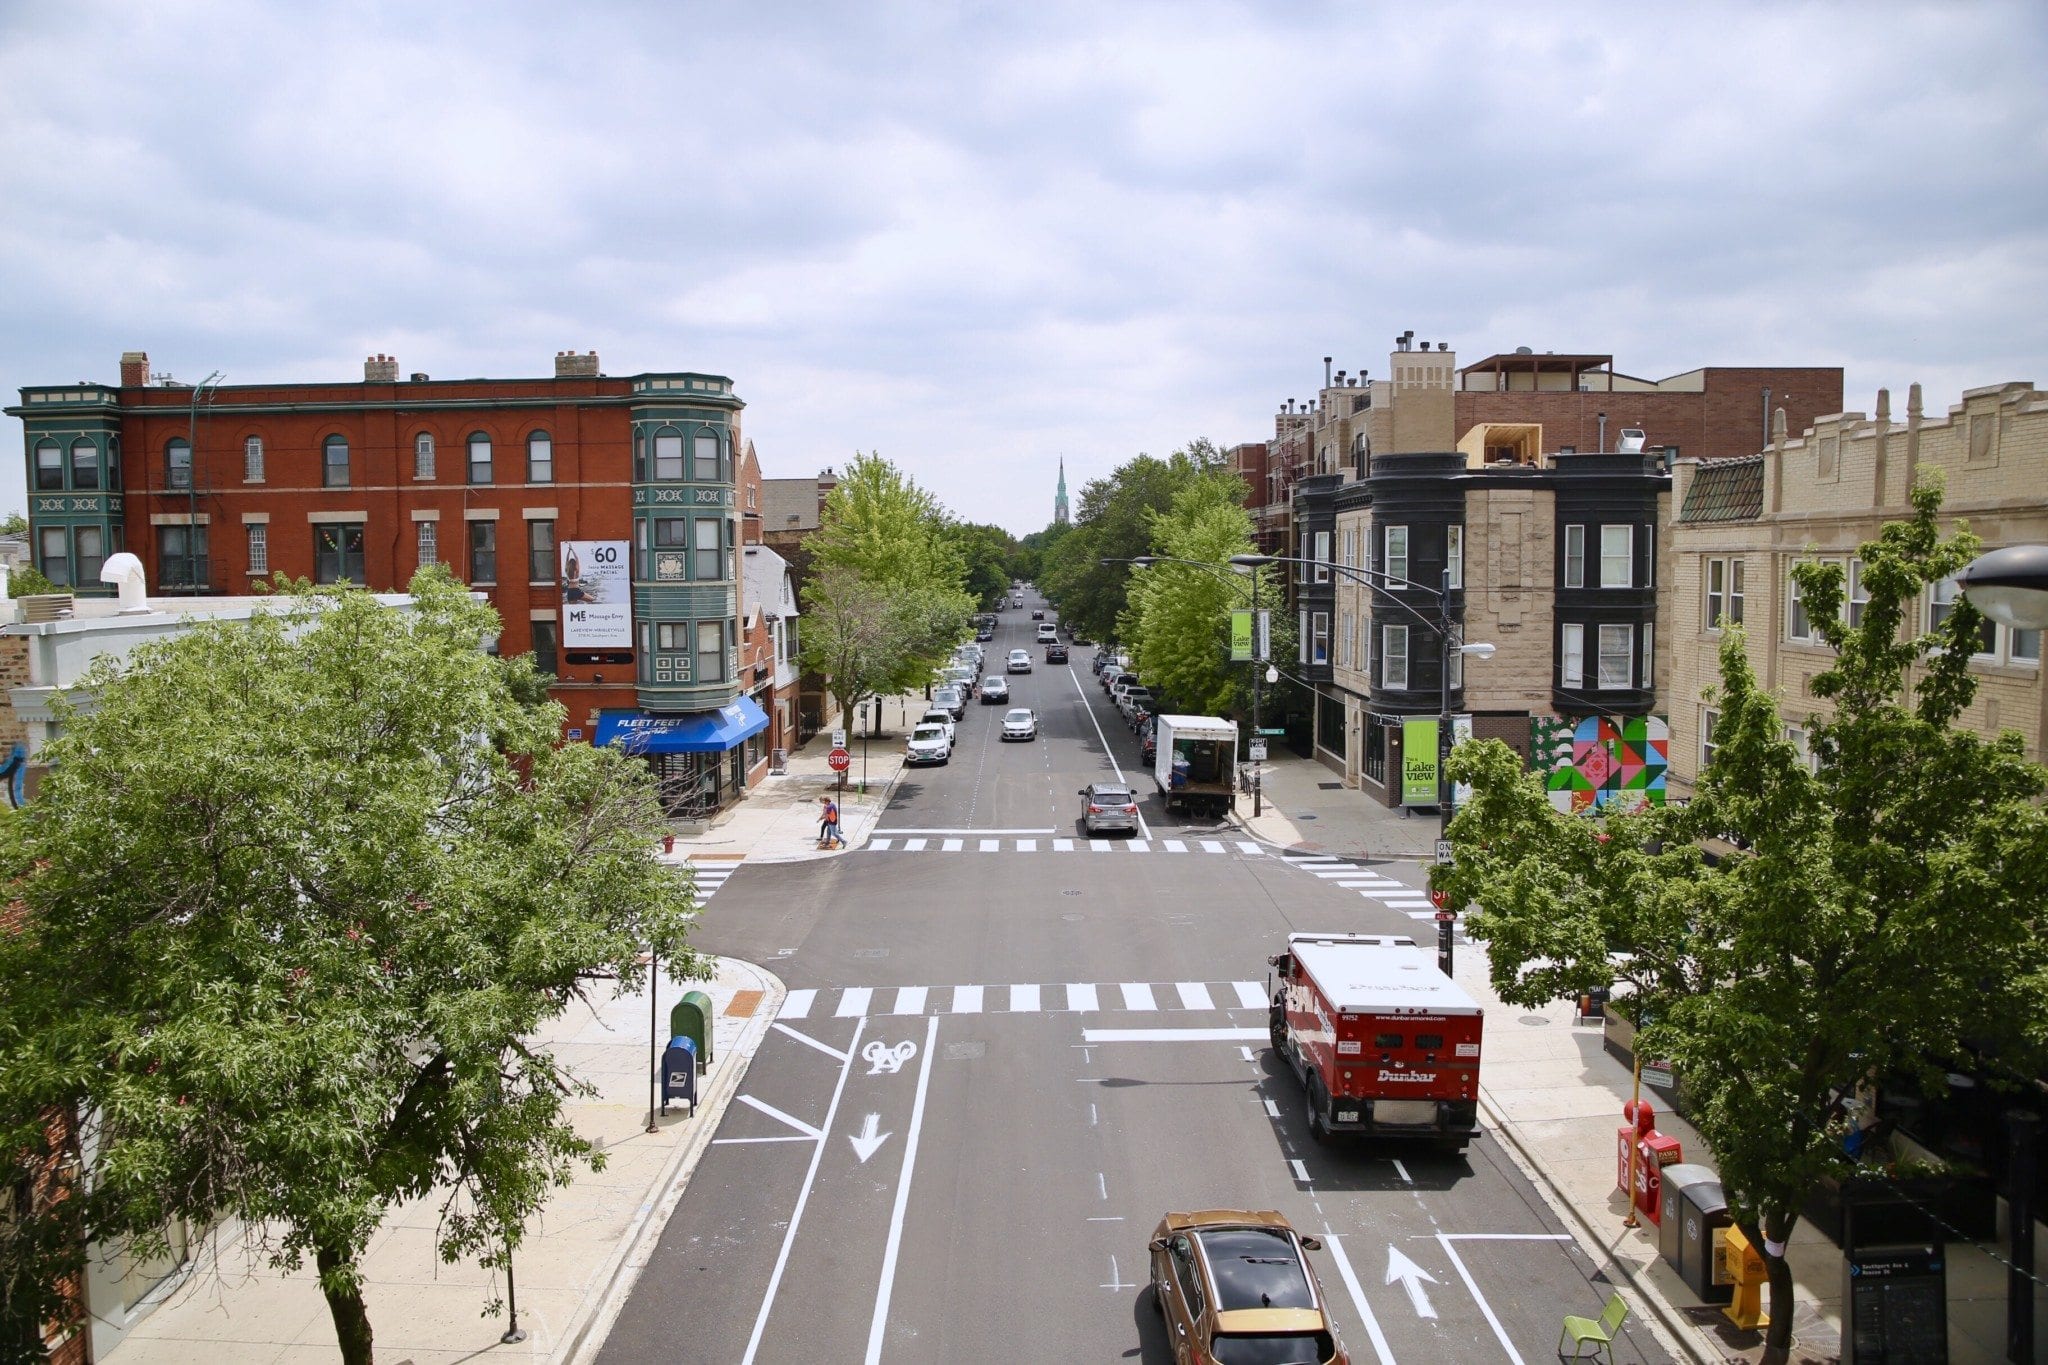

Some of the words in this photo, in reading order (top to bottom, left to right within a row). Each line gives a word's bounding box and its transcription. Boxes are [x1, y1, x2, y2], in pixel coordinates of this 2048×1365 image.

[570, 610, 587, 622] ME
[588, 612, 611, 621] Massage
[611, 612, 624, 621] Envy
[617, 719, 653, 727] FLEET
[653, 718, 684, 727] FEET
[829, 755, 849, 765] STOP
[1406, 761, 1435, 771] Lake
[1405, 772, 1435, 781] view
[1439, 843, 1453, 851] ON
[1438, 851, 1450, 859] WA
[1377, 1069, 1437, 1082] Dunbar
[1658, 1150, 1678, 1158] PAWS
